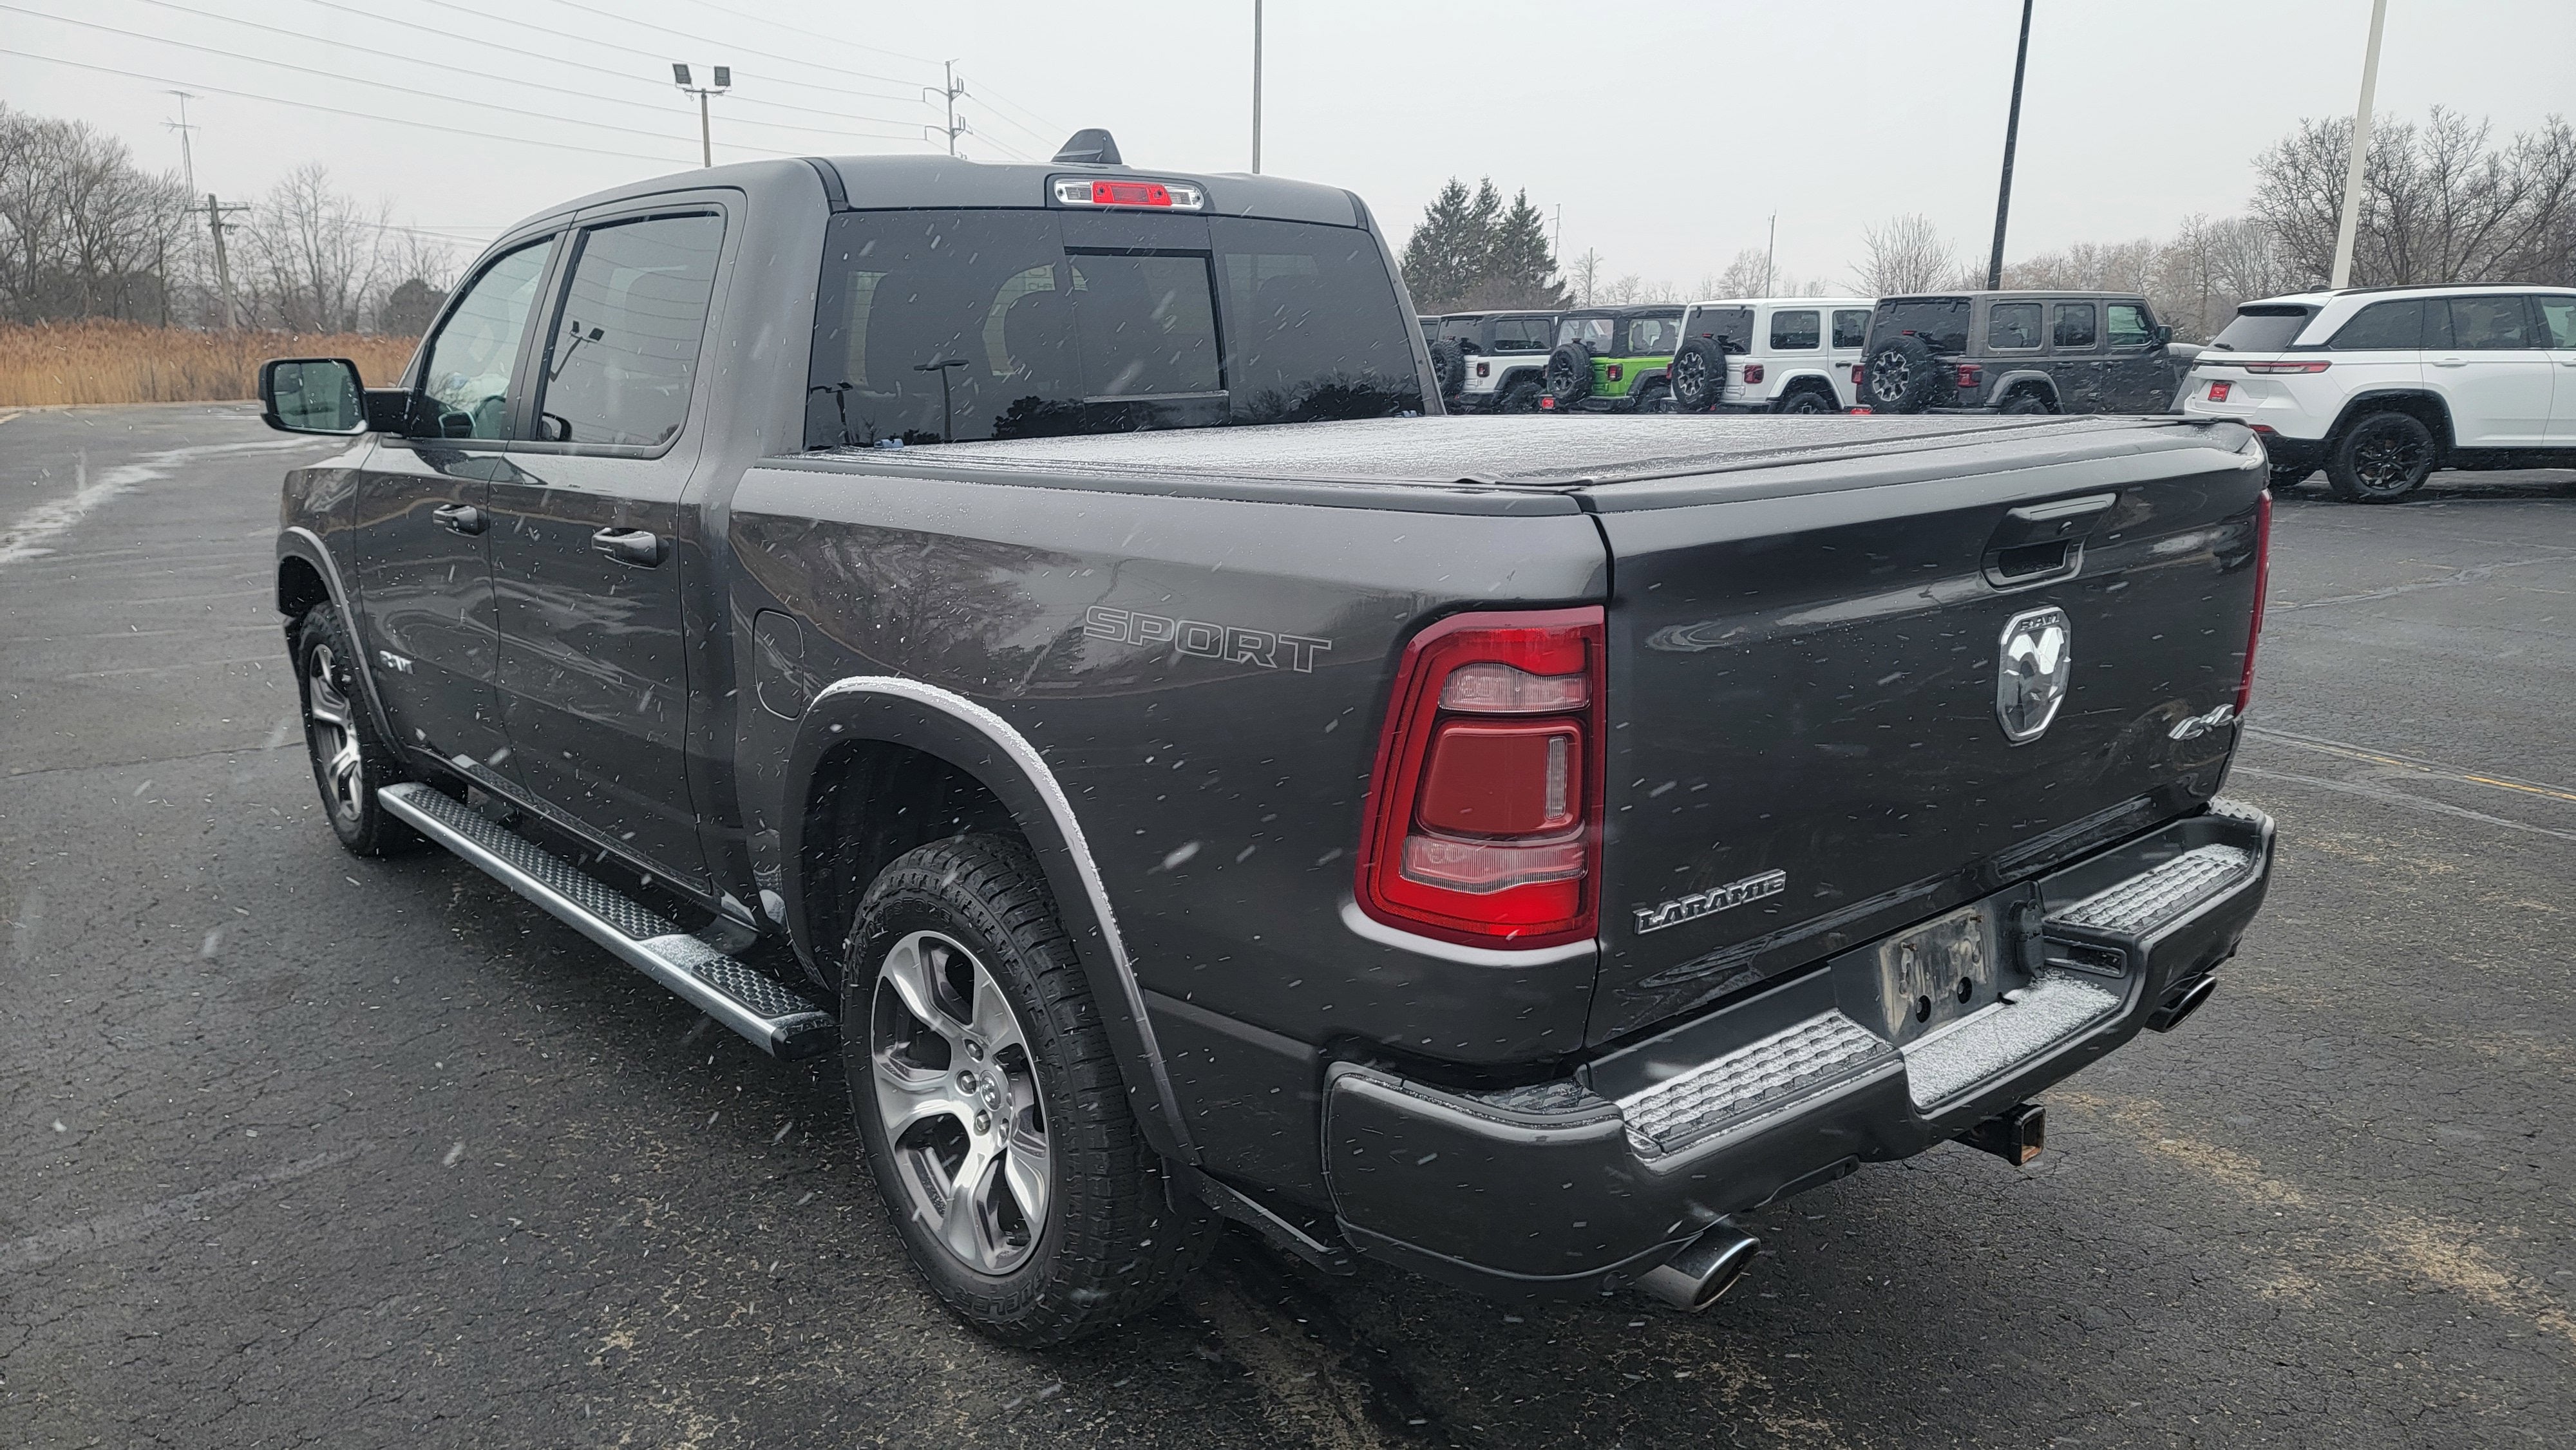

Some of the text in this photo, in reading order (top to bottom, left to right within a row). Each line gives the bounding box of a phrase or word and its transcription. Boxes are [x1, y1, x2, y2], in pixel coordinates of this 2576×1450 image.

[1083, 605, 1332, 673] SPORT
[2020, 613, 2060, 631] RAM
[379, 650, 414, 675] RAM
[1633, 868, 1786, 935] LARAMIE
